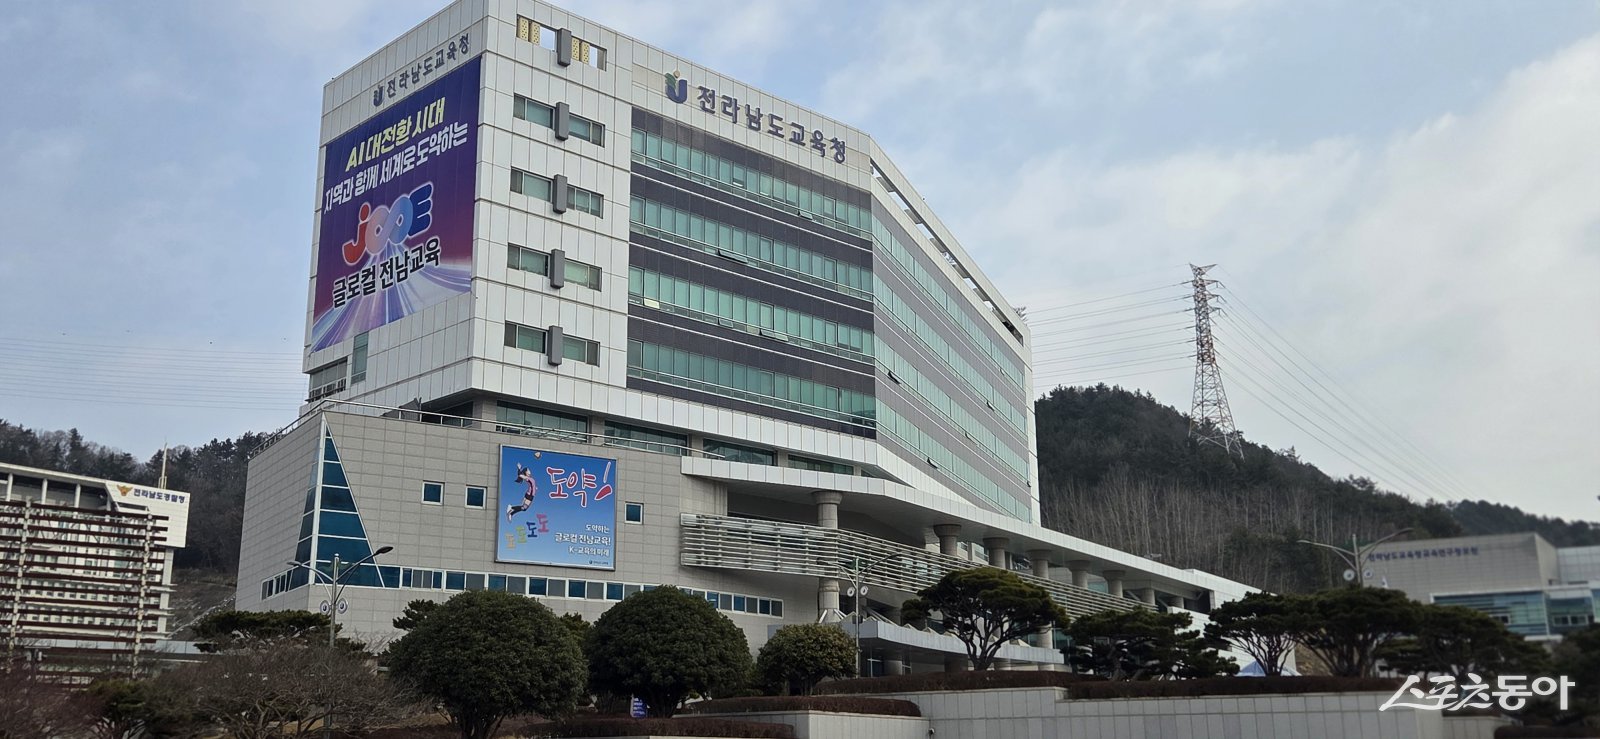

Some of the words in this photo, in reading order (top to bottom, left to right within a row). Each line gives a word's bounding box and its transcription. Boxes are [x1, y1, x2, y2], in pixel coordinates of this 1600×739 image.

[387, 33, 469, 98] 전라남도교육청
[345, 141, 365, 172] AI
[365, 115, 412, 162] 대전환
[412, 97, 446, 138] 시대
[697, 85, 846, 164] 전라남도교육청
[324, 176, 354, 214] 지역과
[354, 164, 379, 197] 함께
[333, 264, 376, 308] 글로컬
[379, 236, 441, 290] 전남교육
[555, 532, 578, 544] 글로컬
